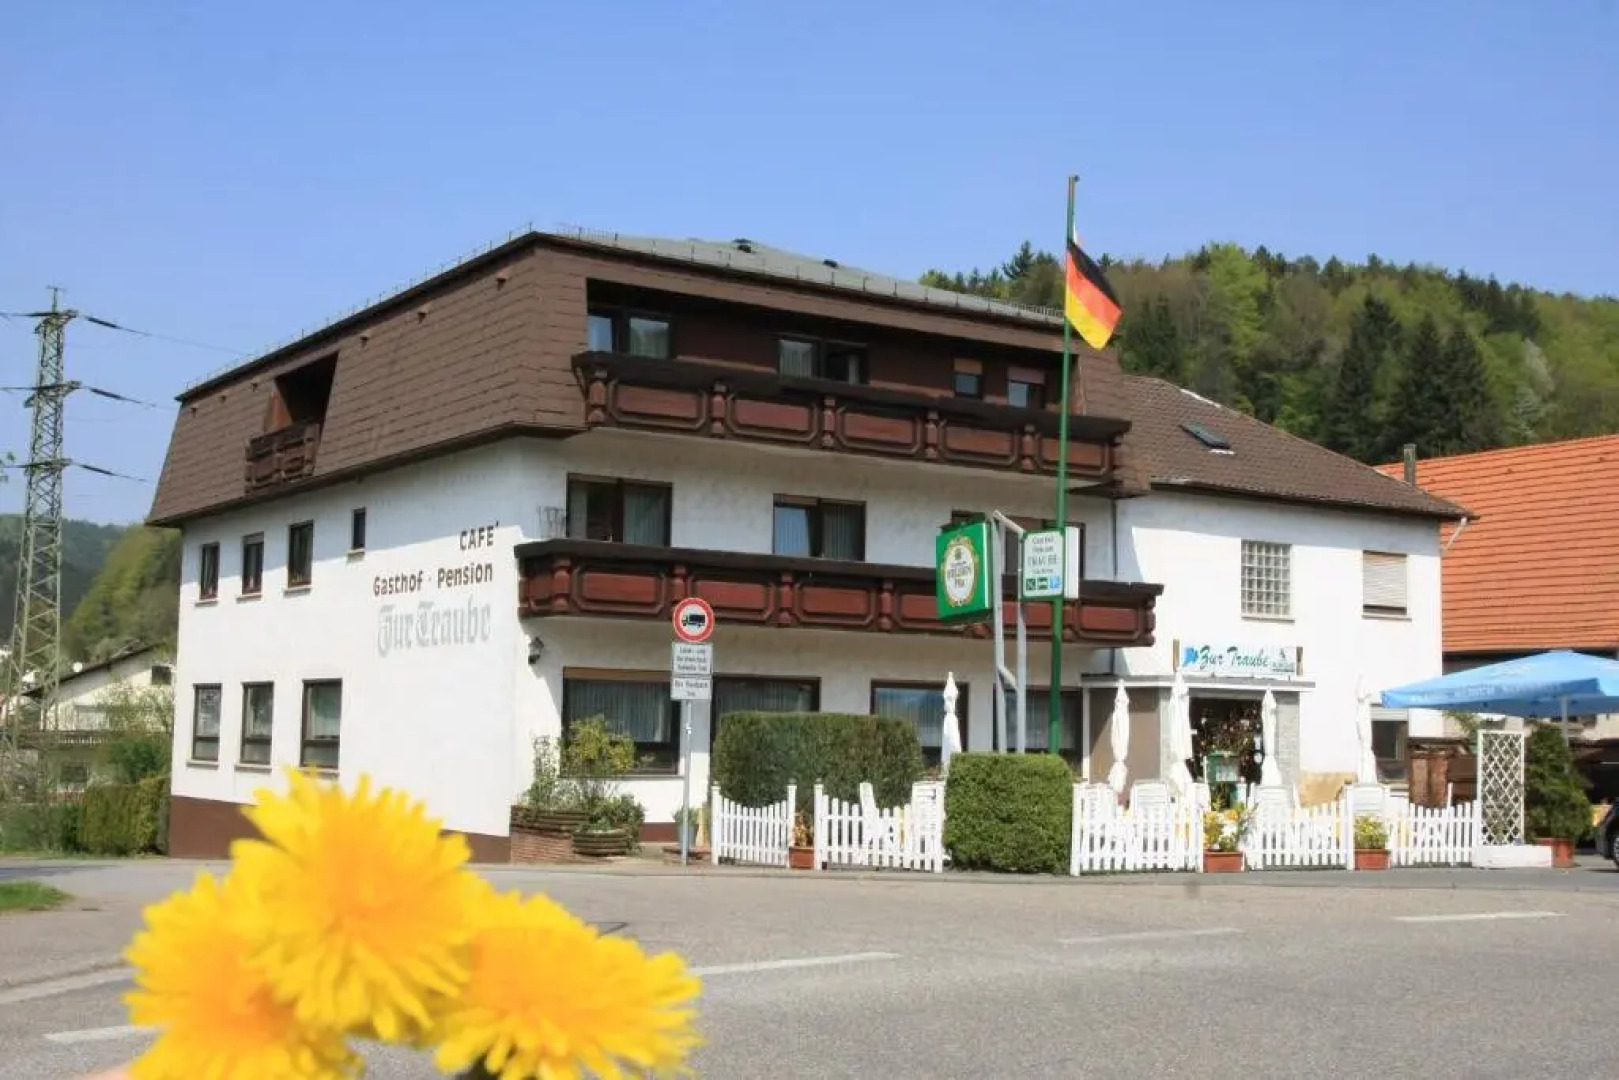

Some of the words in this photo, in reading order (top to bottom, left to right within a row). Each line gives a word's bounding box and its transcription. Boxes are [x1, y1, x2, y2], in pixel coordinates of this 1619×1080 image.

[373, 570, 424, 597] Gasthof
[437, 562, 493, 589] Pension
[377, 603, 414, 658] Zur
[416, 594, 492, 648] Traube
[1199, 645, 1224, 670] Zur
[1226, 646, 1269, 668] Traube
